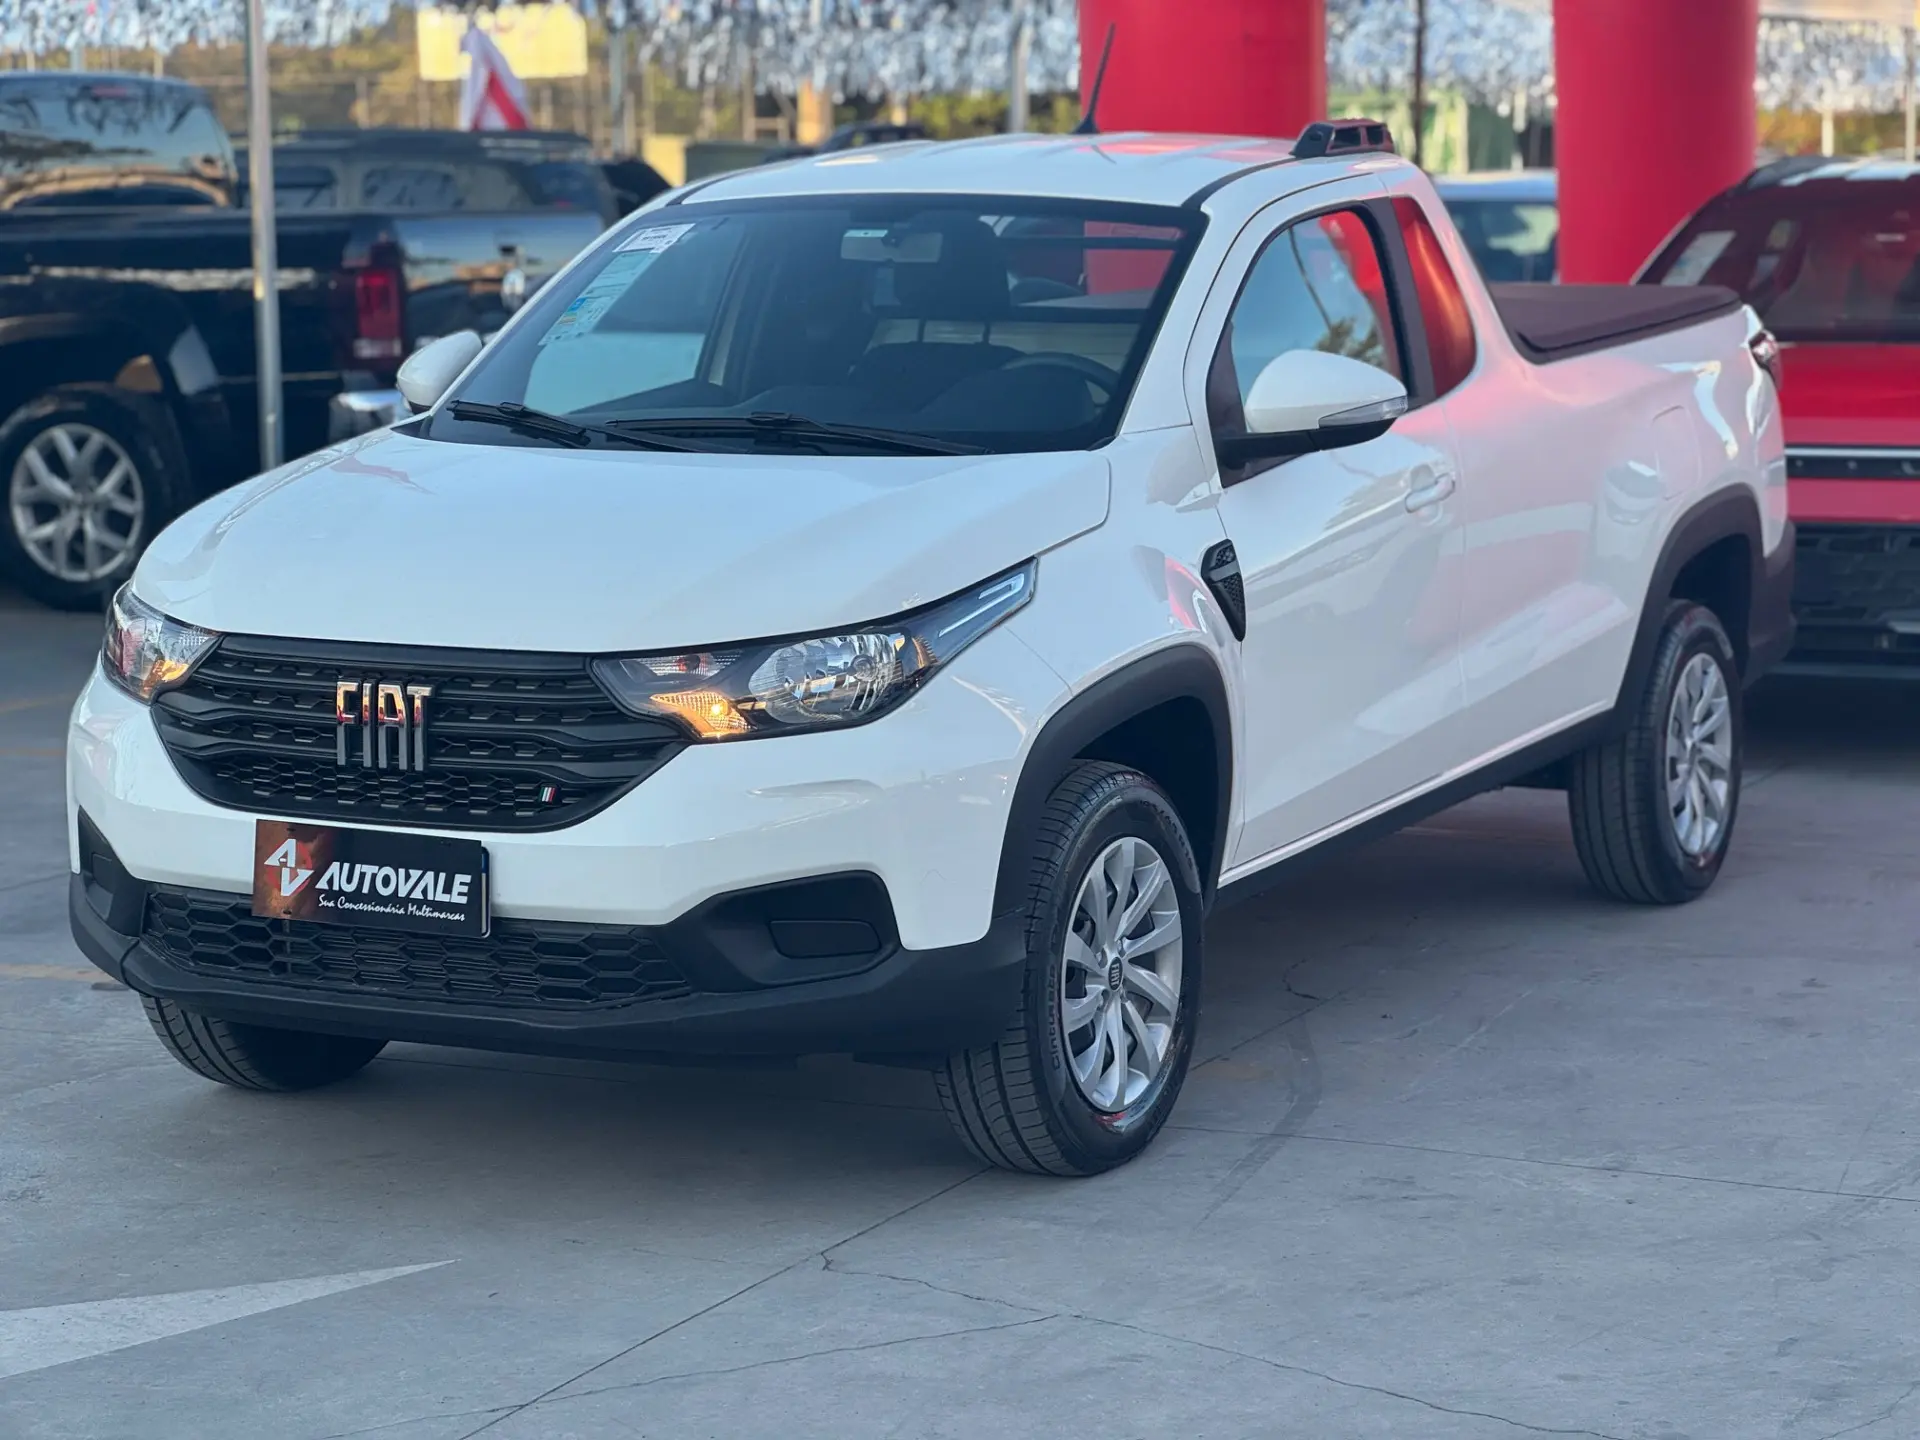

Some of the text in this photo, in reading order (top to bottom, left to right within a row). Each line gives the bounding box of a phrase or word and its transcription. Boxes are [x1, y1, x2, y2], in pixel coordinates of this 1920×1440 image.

[336, 681, 433, 771] FIAT
[315, 861, 471, 904] AUTOVALE
[318, 894, 466, 922] Sua Concessionária Multimarcas
